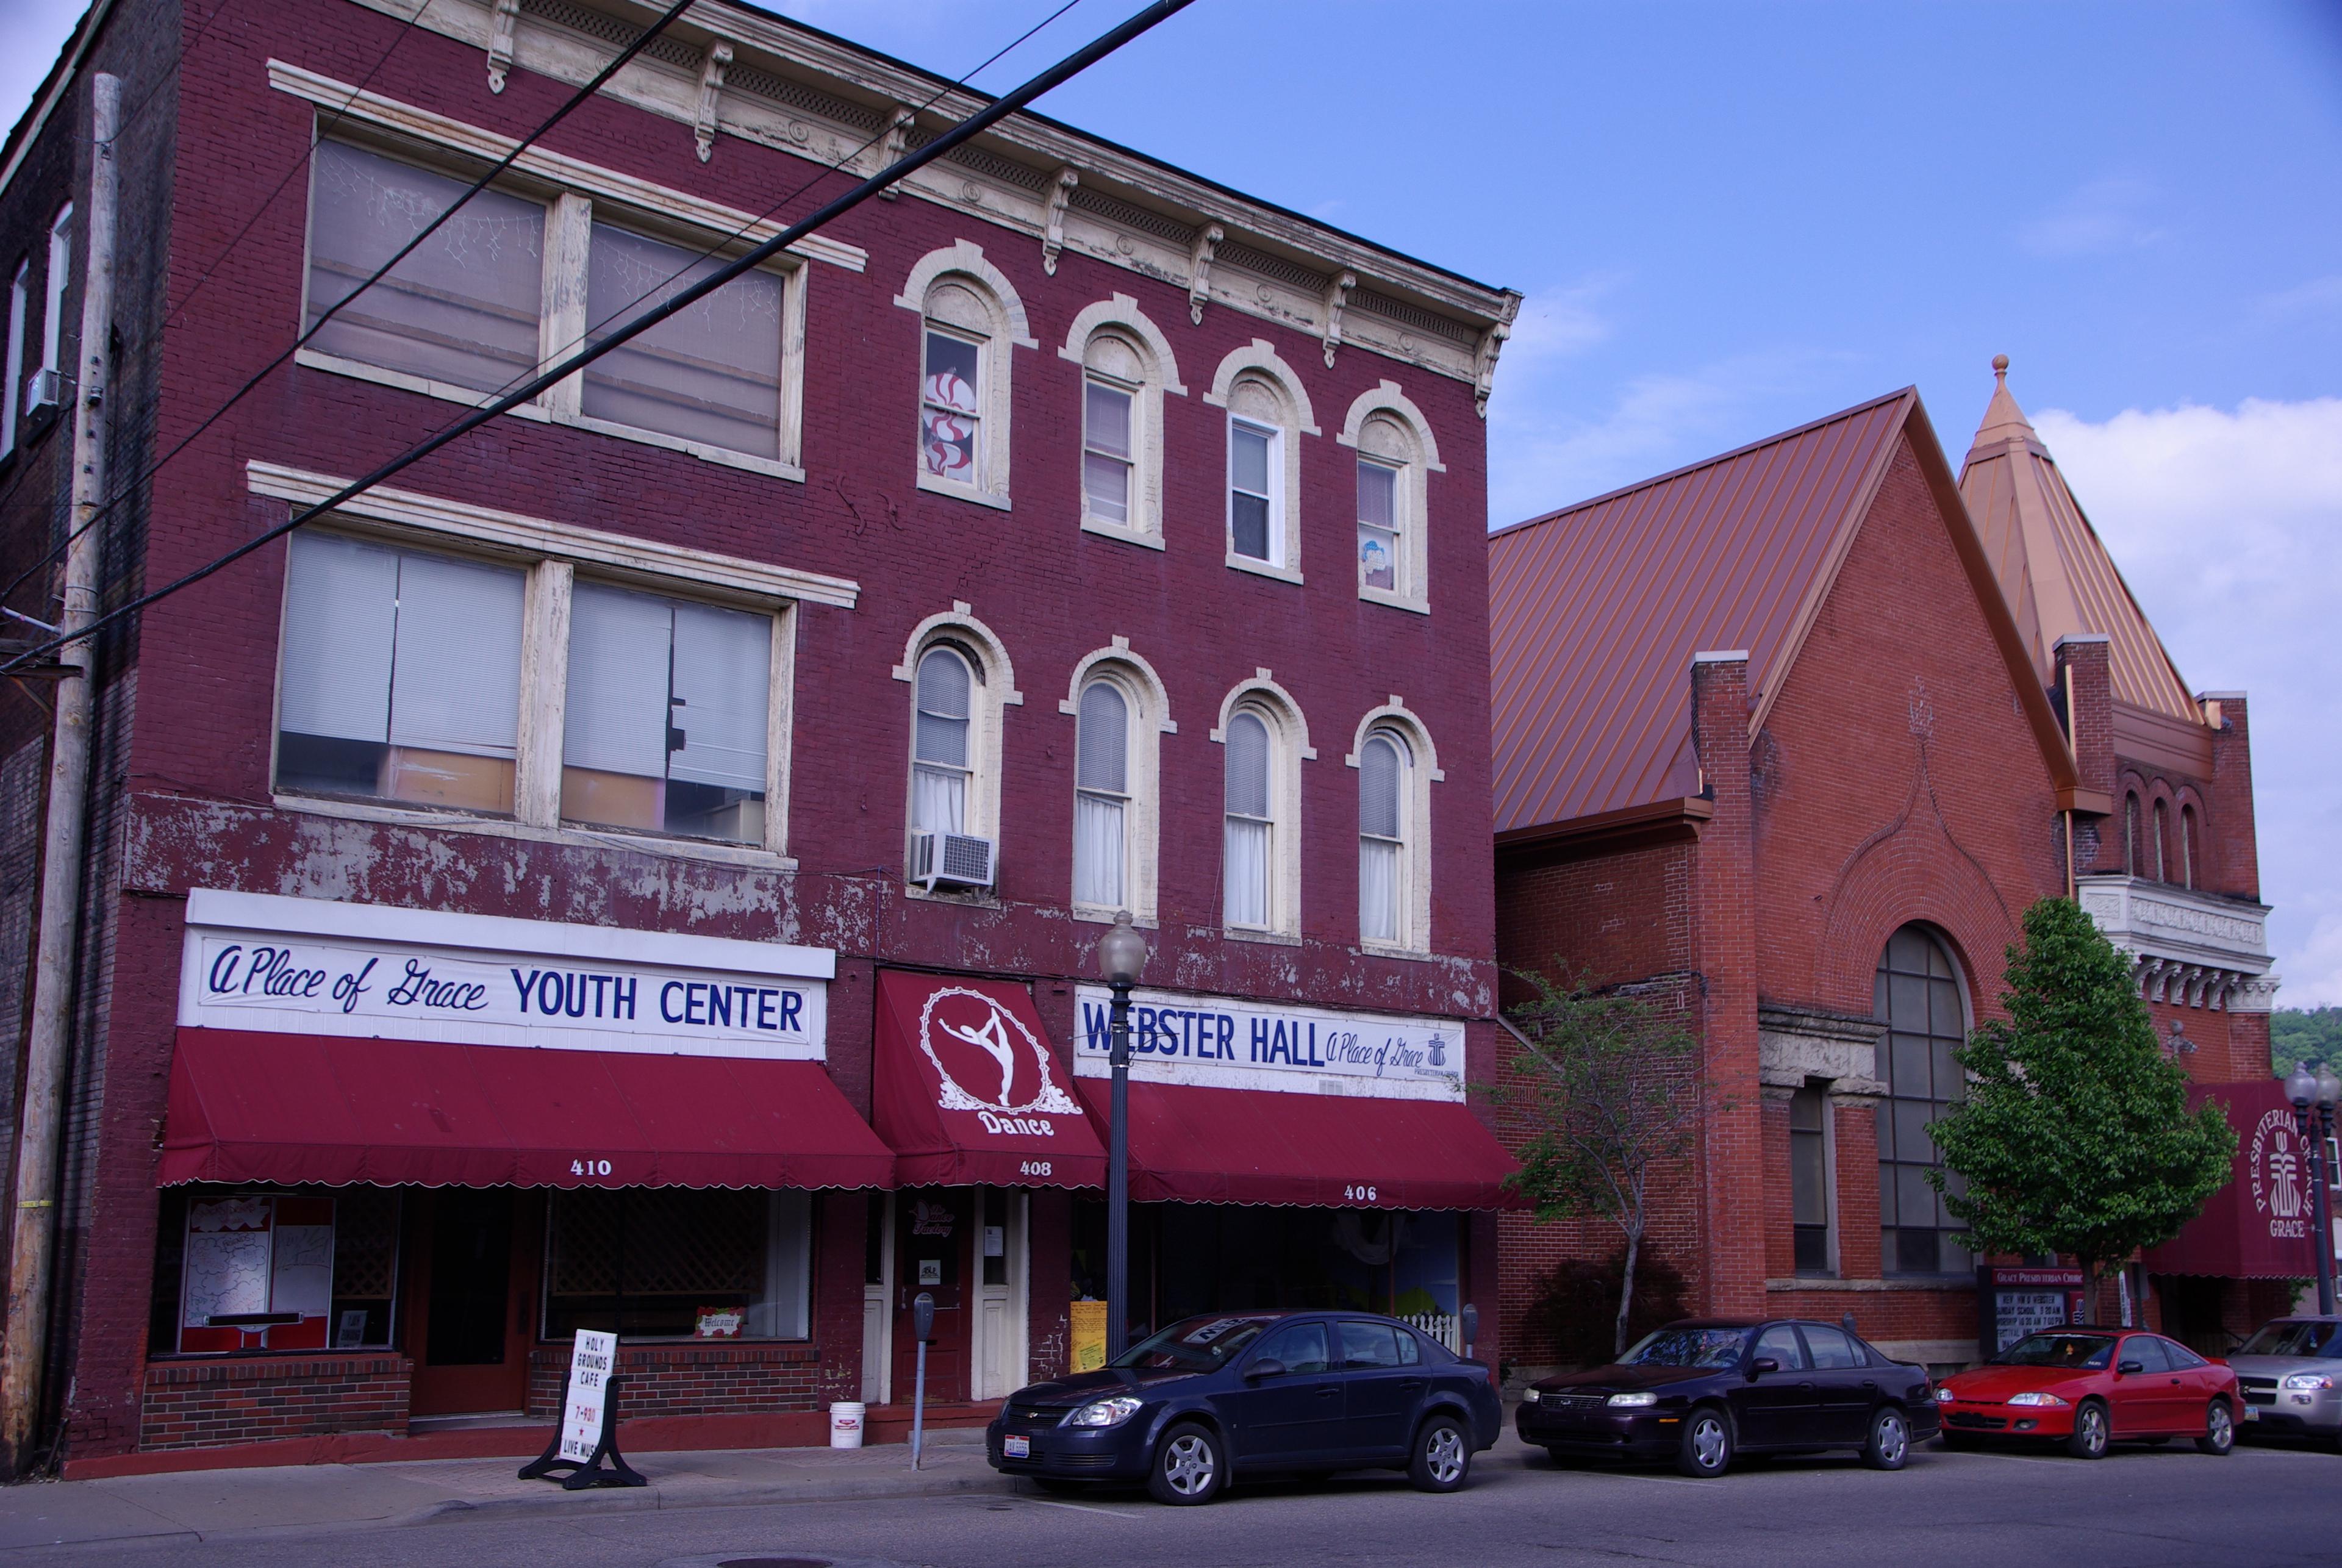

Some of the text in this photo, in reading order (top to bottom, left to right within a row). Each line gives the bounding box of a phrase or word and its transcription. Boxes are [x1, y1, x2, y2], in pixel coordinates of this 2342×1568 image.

[243, 947, 324, 997] Place
[332, 957, 379, 1014] of
[387, 959, 489, 1010] Grace
[510, 968, 636, 1020] YOUTH
[660, 981, 803, 1032] CENTER
[1083, 1003, 1235, 1061] WEBSTER
[1250, 1017, 1325, 1067] HALL
[1338, 1032, 1373, 1064] Place
[1373, 1038, 1392, 1077] of
[1389, 1037, 1423, 1069] Grace
[976, 1111, 1055, 1137] Dance
[570, 1159, 612, 1176] 410
[1019, 1161, 1053, 1176] 408
[2250, 1109, 2299, 1214] PRESBYTERIAN
[1343, 1184, 1378, 1201] 406
[2269, 1219, 2305, 1238] GRACE
[2019, 1272, 2061, 1283] PRESBYTERIAN
[2063, 1272, 2084, 1283] CHURC
[704, 1317, 735, 1328] Welcome
[585, 1337, 604, 1352] HOLY
[577, 1353, 607, 1371] GROUNDS
[580, 1371, 598, 1387] CAFE
[563, 1439, 596, 1458] LIVE MUS
